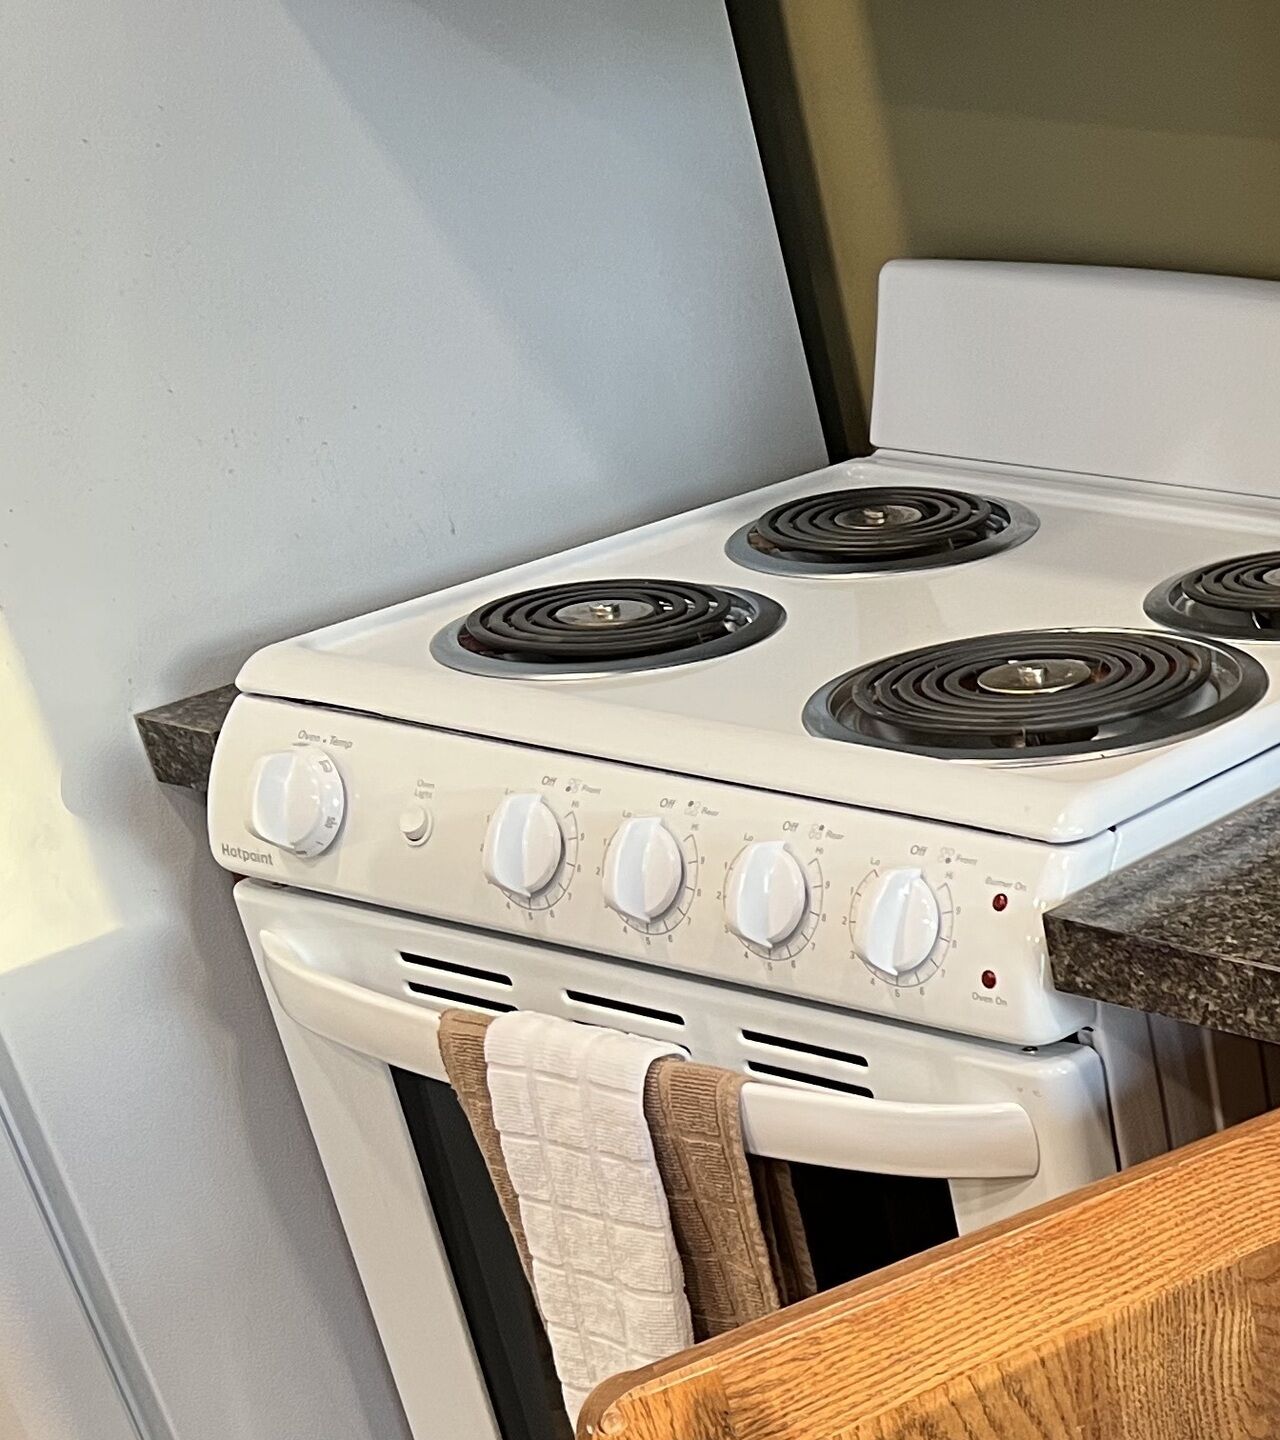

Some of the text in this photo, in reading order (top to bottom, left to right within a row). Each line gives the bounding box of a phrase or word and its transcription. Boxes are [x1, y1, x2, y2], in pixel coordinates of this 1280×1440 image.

[329, 735, 353, 749] Temp
[541, 775, 557, 787] Off
[660, 798, 676, 808] Off
[782, 820, 799, 832] Off
[221, 843, 274, 866] Hotpoint
[910, 844, 928, 857] Off
